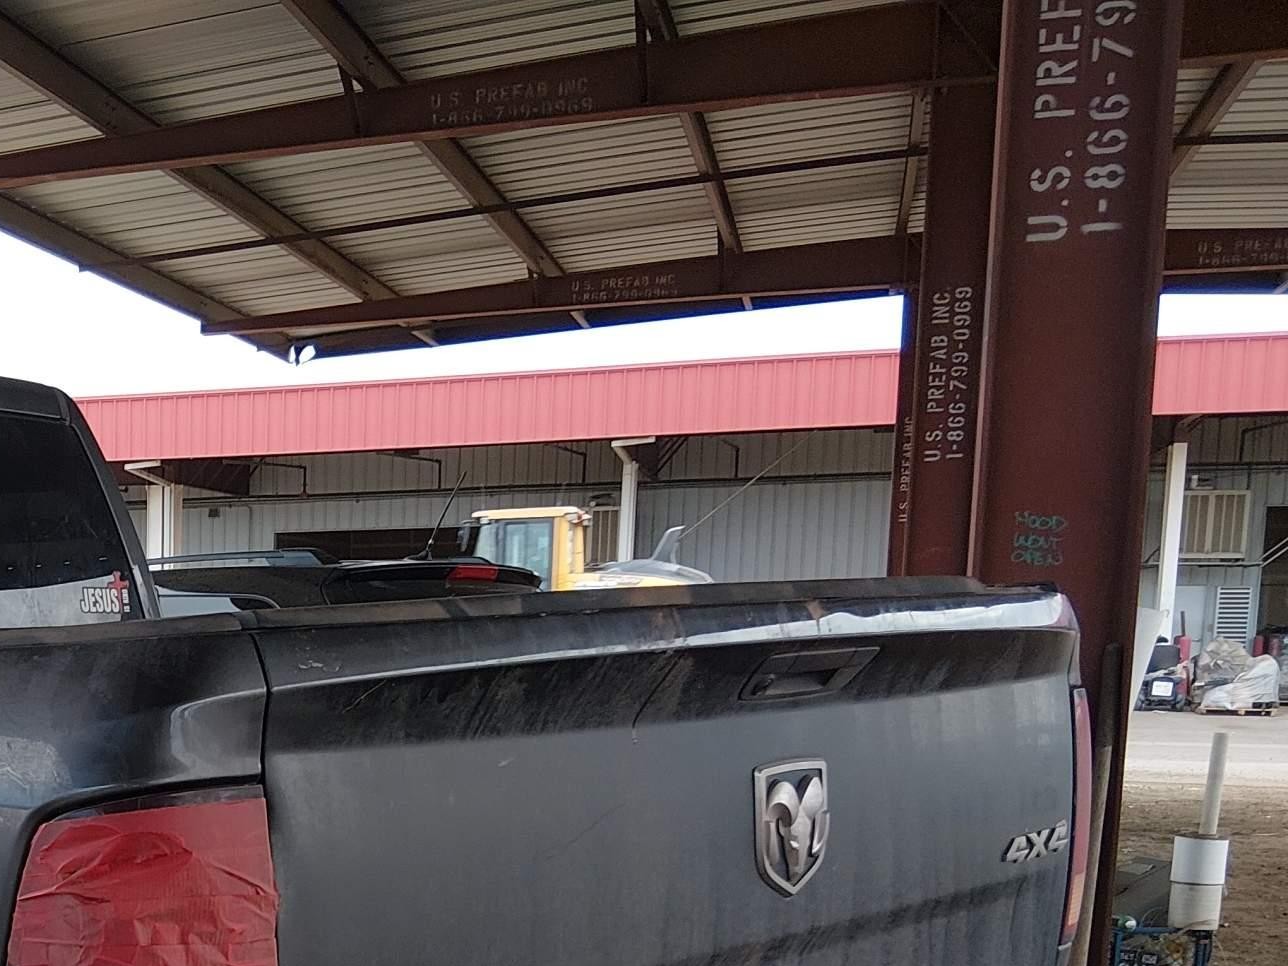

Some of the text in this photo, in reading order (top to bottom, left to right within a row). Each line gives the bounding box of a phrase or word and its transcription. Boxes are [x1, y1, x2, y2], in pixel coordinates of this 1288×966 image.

[475, 82, 549, 104] PREFAB
[1025, 150, 1073, 242] U.S.
[926, 335, 948, 413] PREFAB
[945, 286, 973, 460] 1-866-799-0969
[923, 424, 943, 463] U.S.
[81, 587, 120, 614] JESUS
